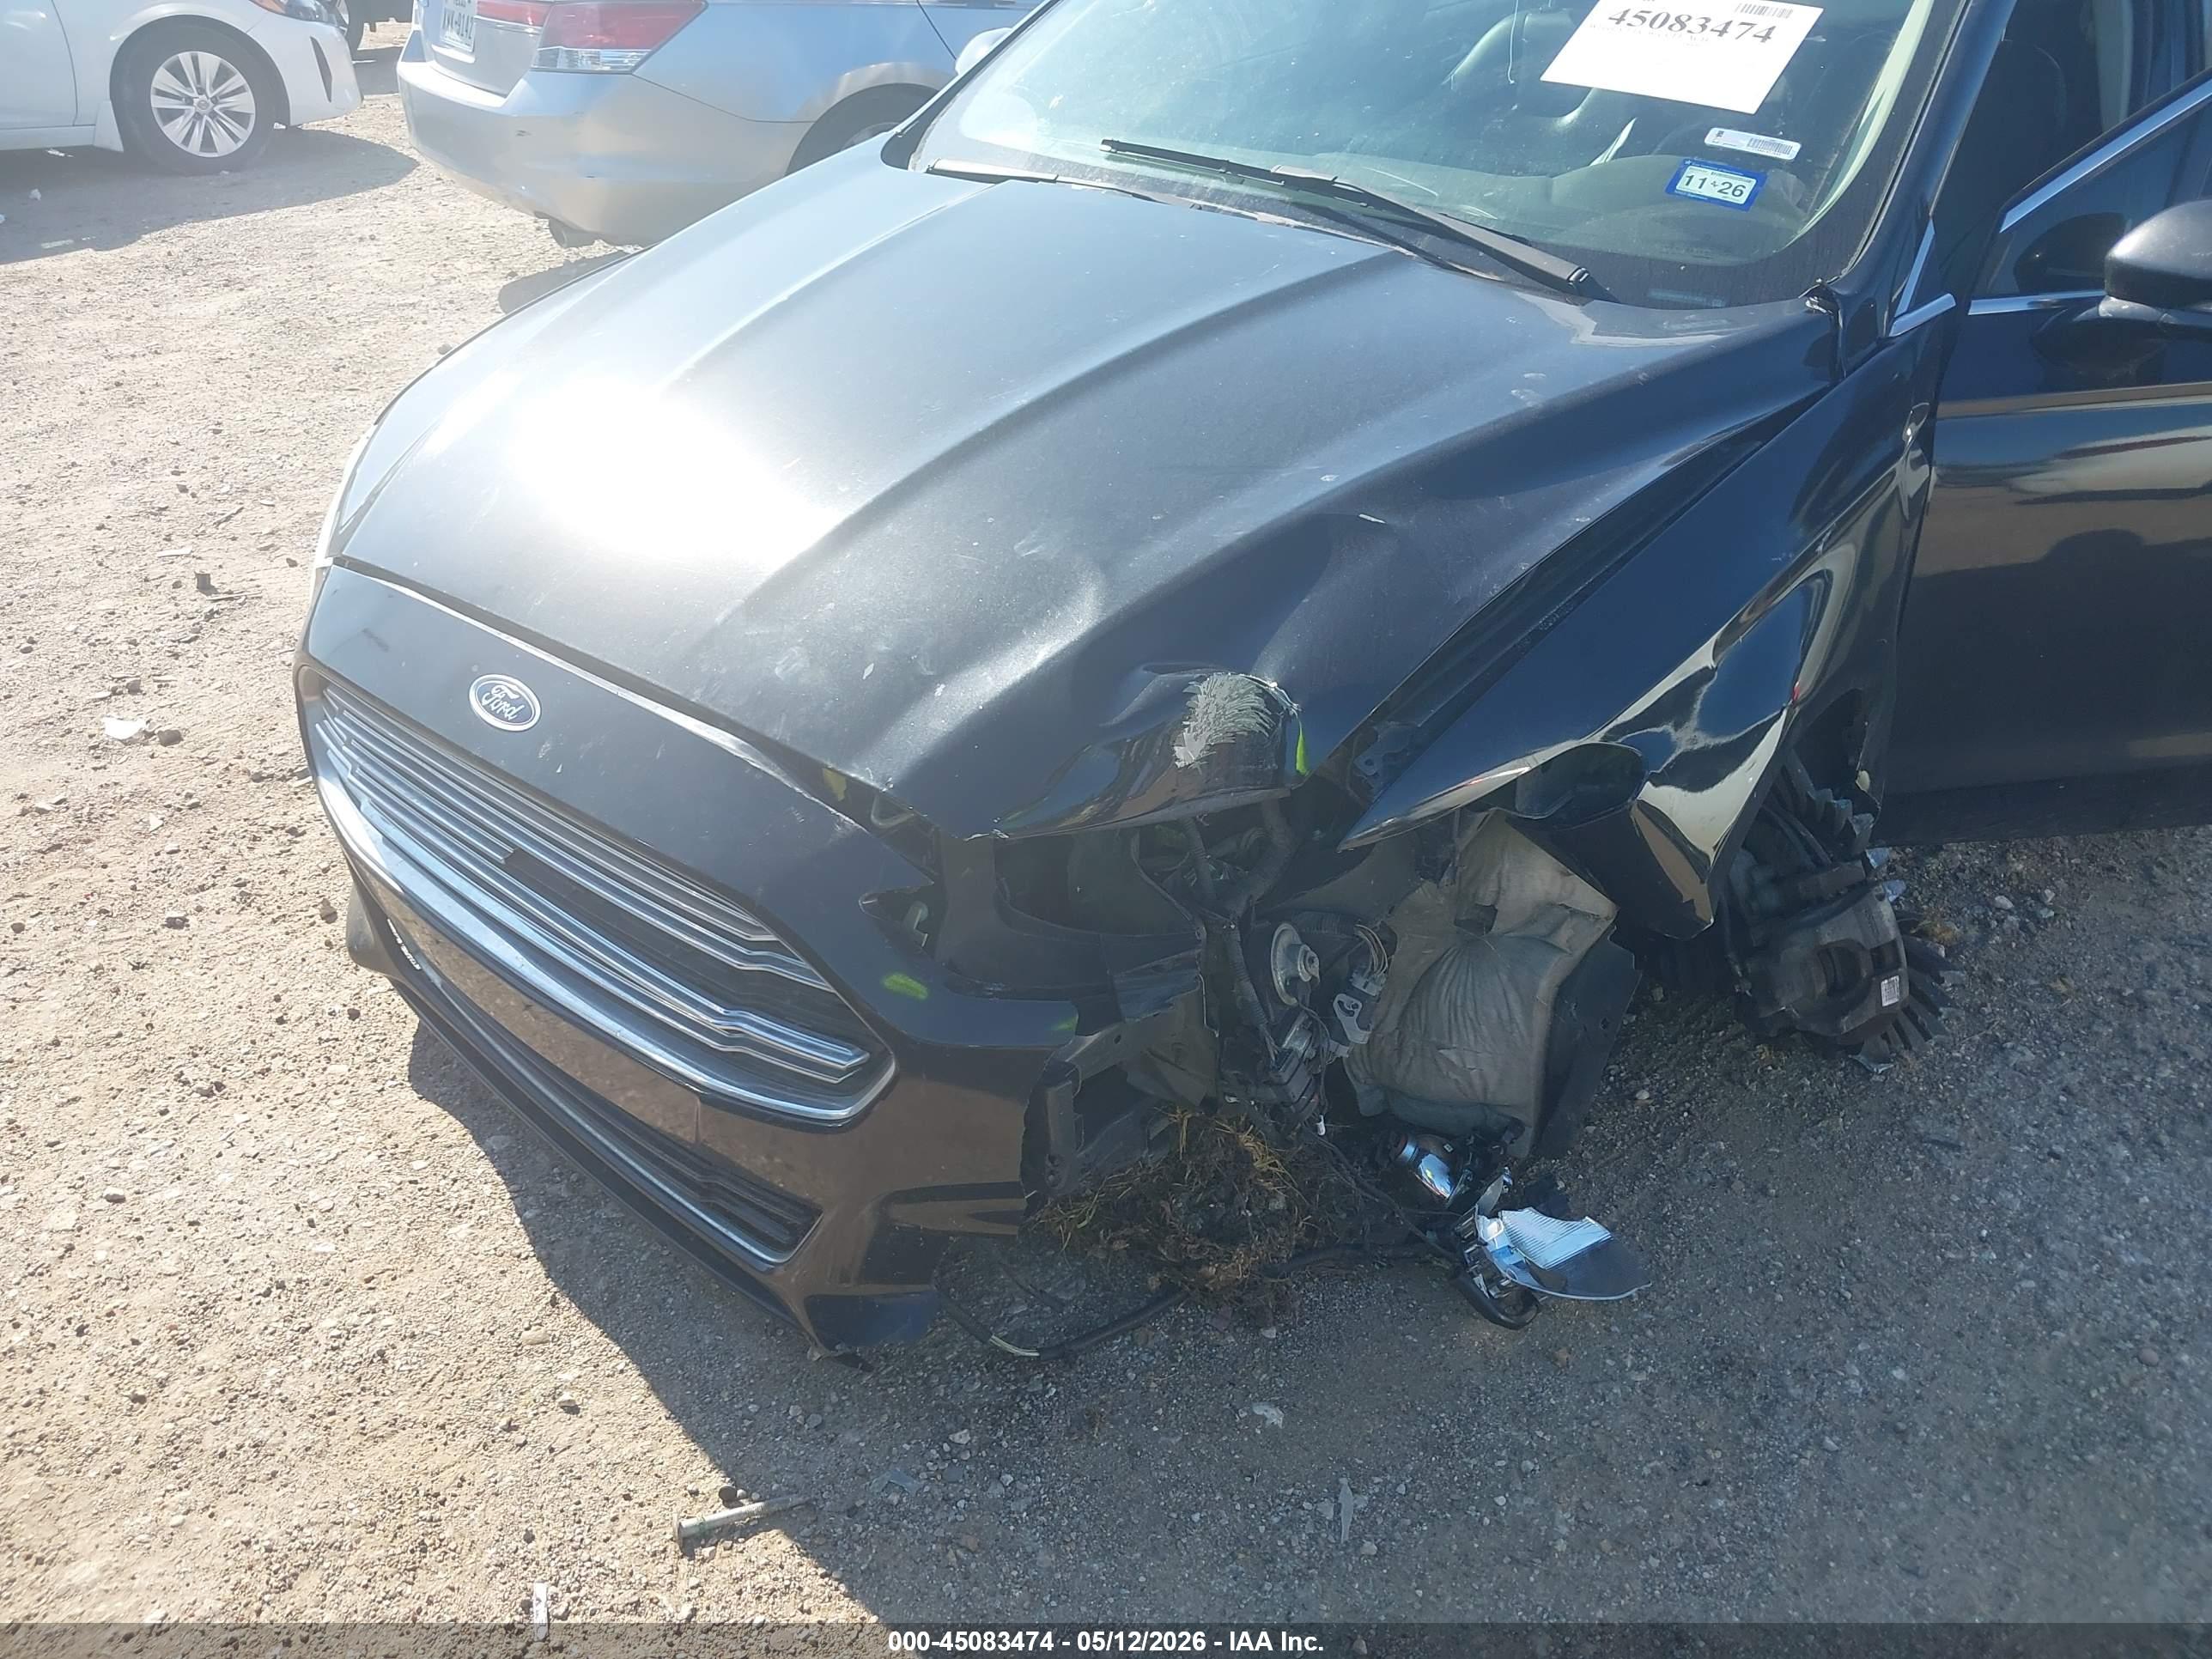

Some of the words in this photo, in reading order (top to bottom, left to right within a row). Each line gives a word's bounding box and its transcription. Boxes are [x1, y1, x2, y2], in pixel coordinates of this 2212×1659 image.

[1607, 8, 1777, 43] 45083474
[1685, 174, 1708, 190] 11
[1717, 181, 1747, 198] 26
[481, 684, 525, 721] Ford
